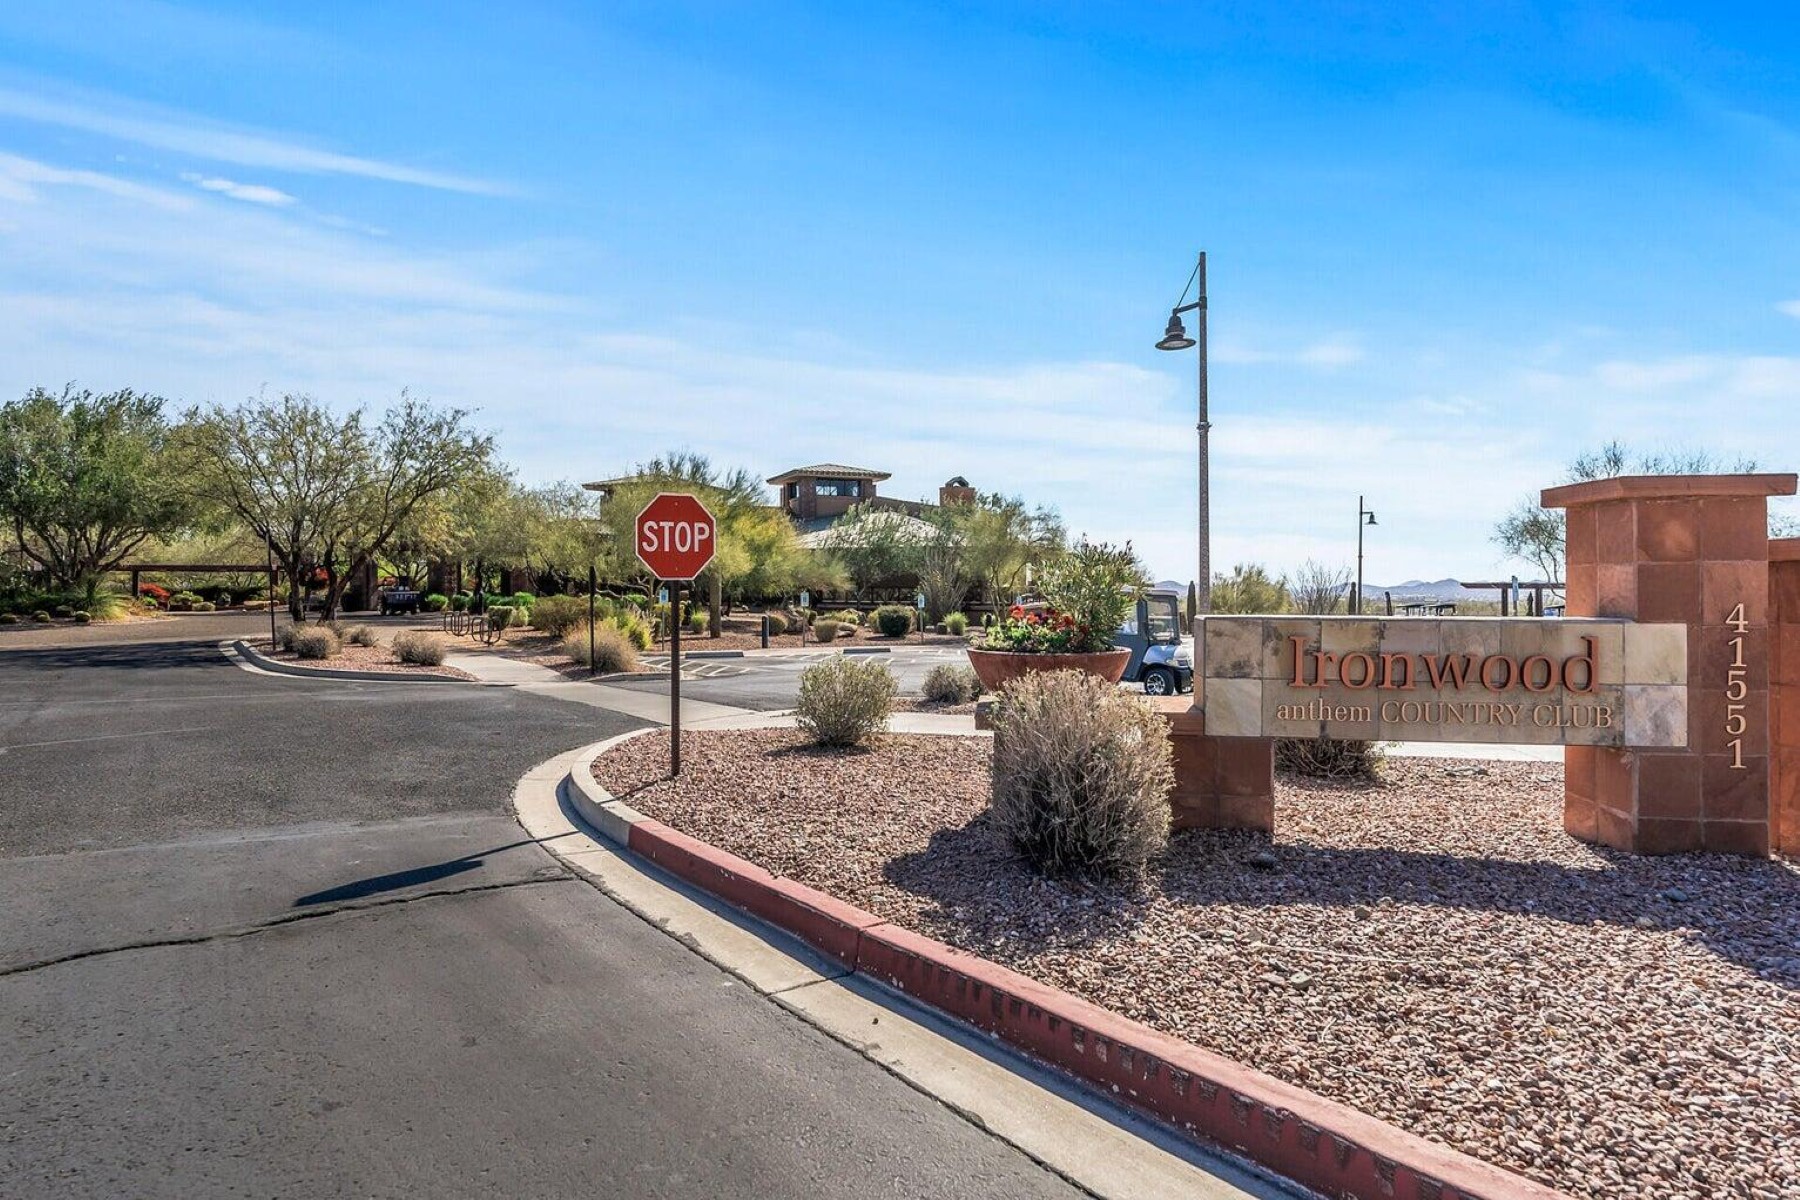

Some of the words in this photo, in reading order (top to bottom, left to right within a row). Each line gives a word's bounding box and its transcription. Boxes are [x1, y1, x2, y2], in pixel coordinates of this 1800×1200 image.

[641, 520, 710, 553] STOP
[1287, 635, 1600, 694] Ironwood
[1725, 603, 1749, 769] 41551
[1276, 699, 1371, 723] anthem
[1381, 700, 1523, 727] COUNTRY
[1531, 703, 1613, 729] CLUB
